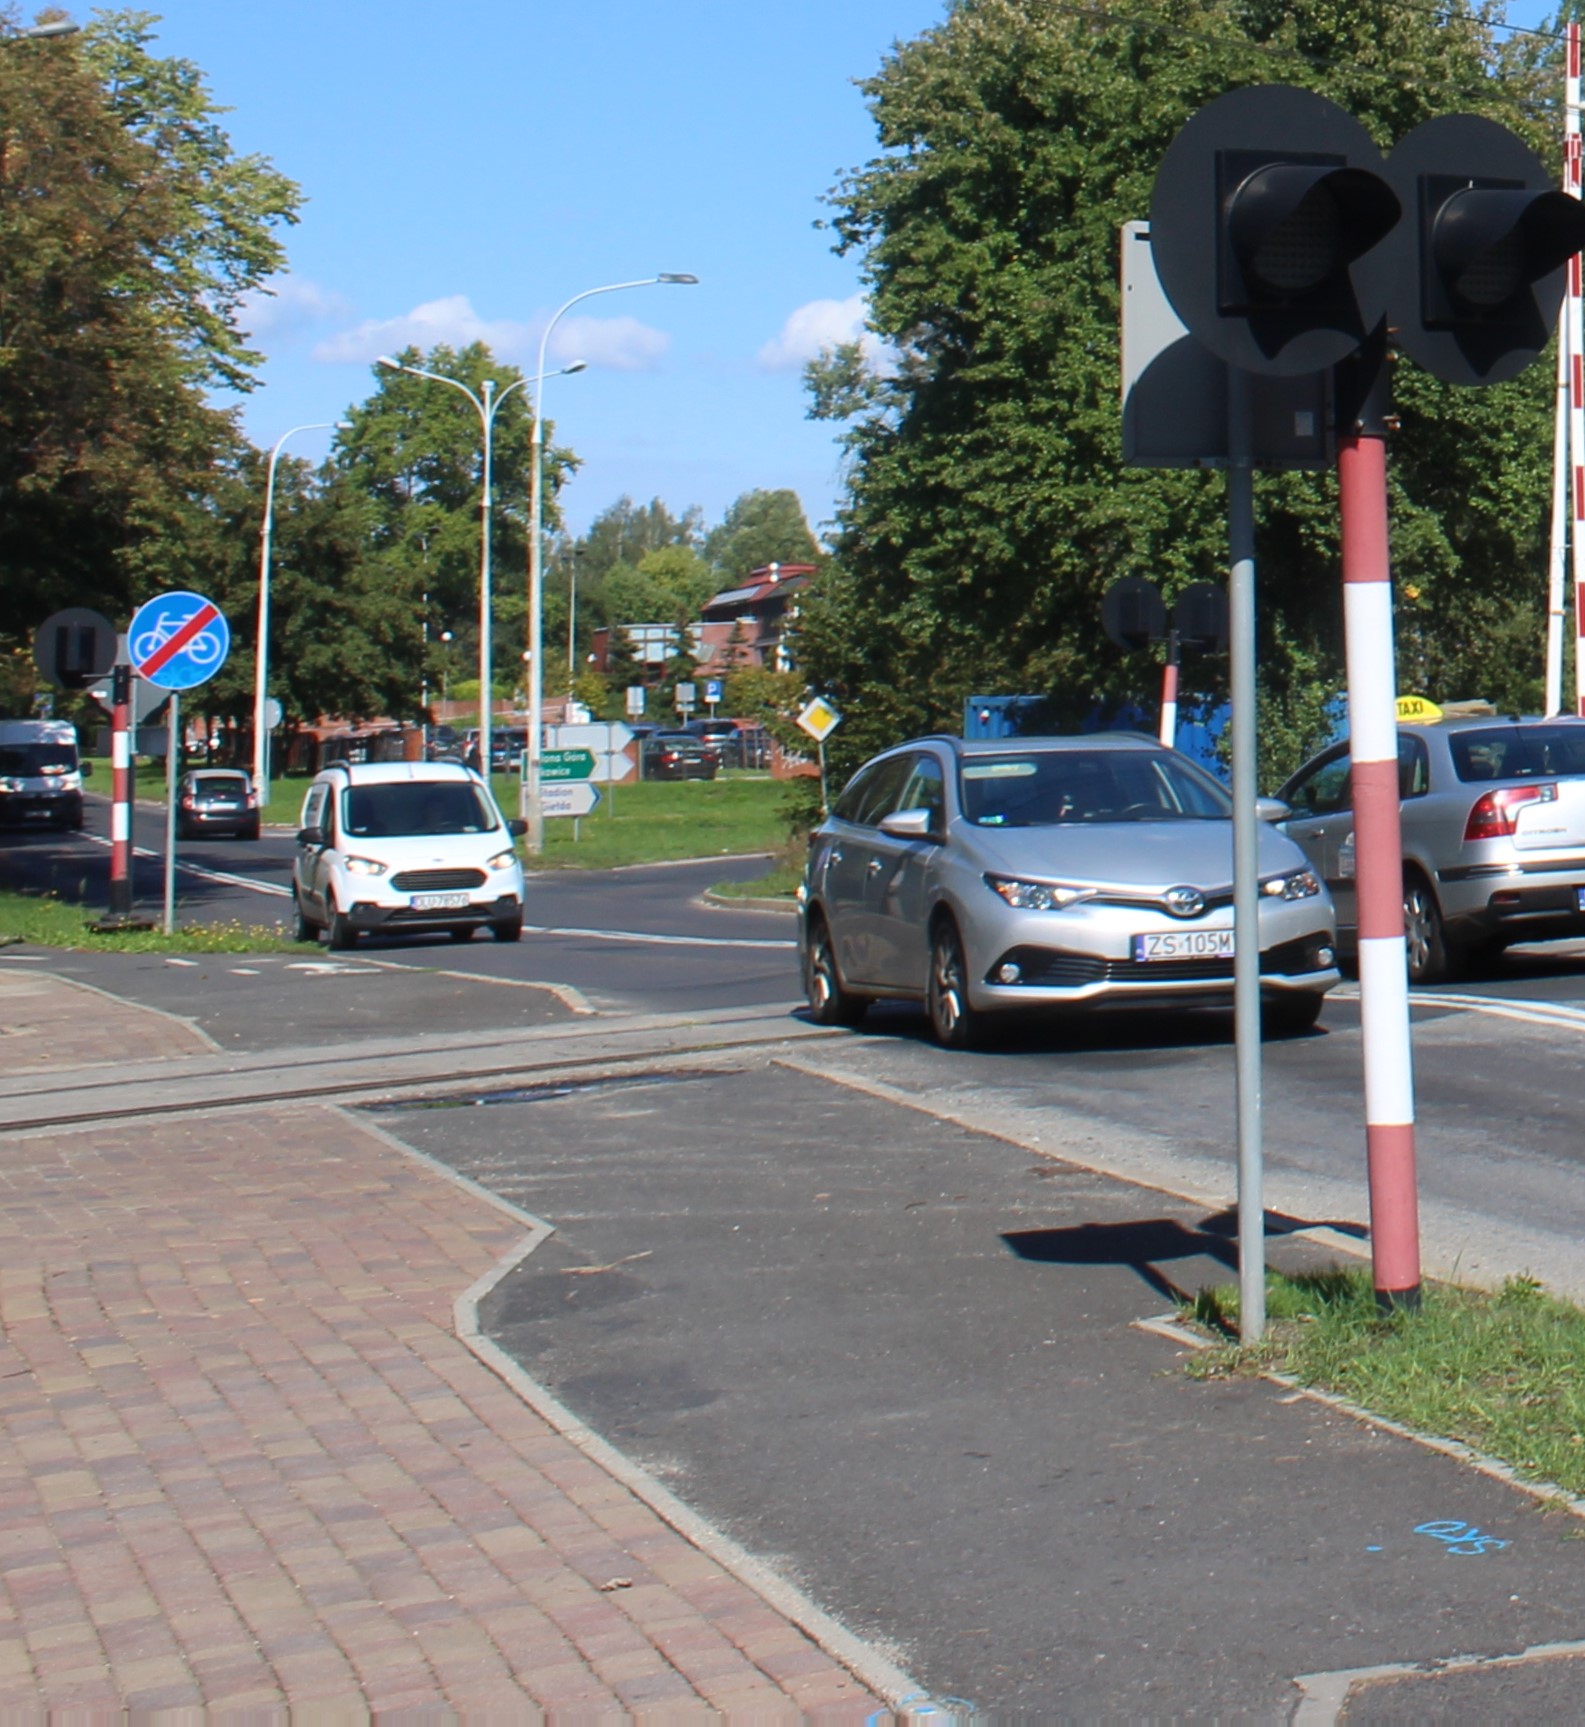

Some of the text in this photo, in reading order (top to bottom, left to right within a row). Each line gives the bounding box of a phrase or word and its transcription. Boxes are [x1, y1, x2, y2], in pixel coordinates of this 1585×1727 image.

[1396, 700, 1424, 716] TAXI
[1148, 932, 1231, 956] ZS 105M
